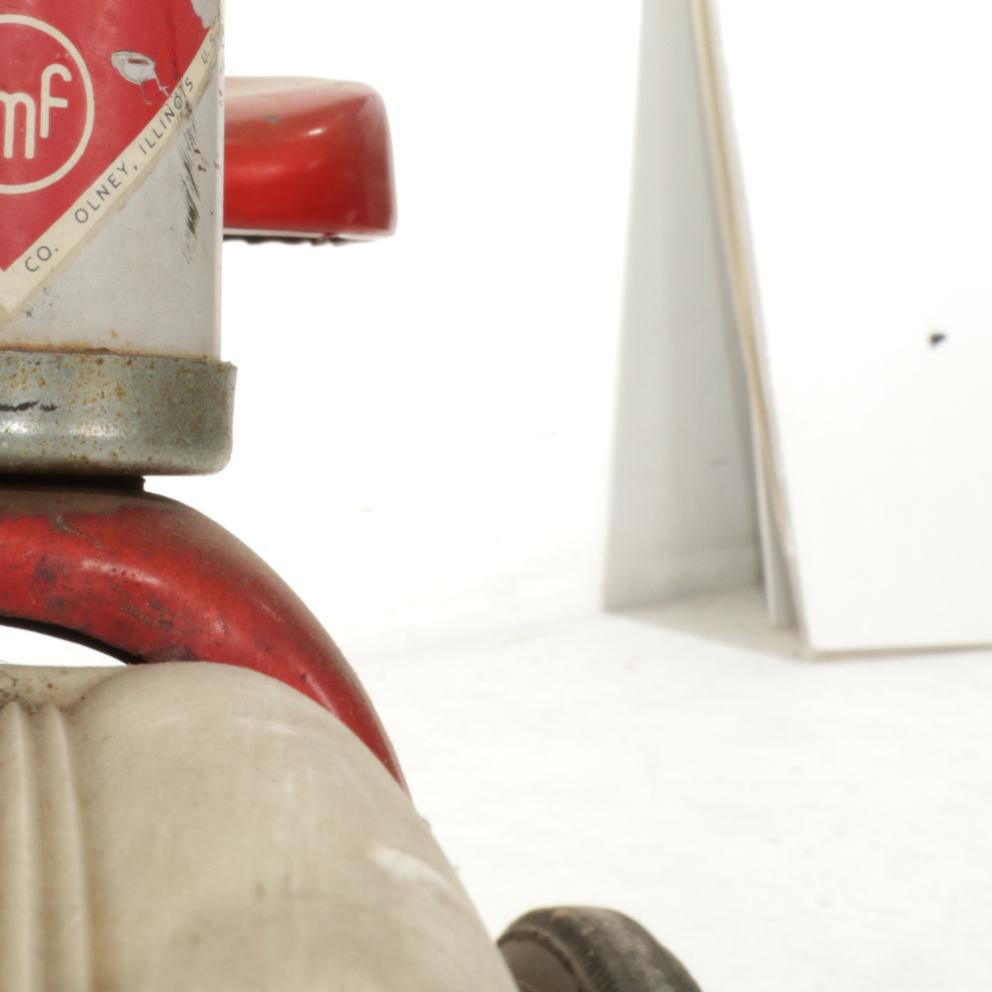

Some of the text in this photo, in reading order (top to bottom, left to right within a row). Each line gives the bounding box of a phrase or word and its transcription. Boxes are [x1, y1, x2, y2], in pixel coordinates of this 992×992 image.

[24, 245, 59, 273] CO.
[74, 159, 139, 224] OLNEY,
[139, 78, 195, 155] ILLINOIS
